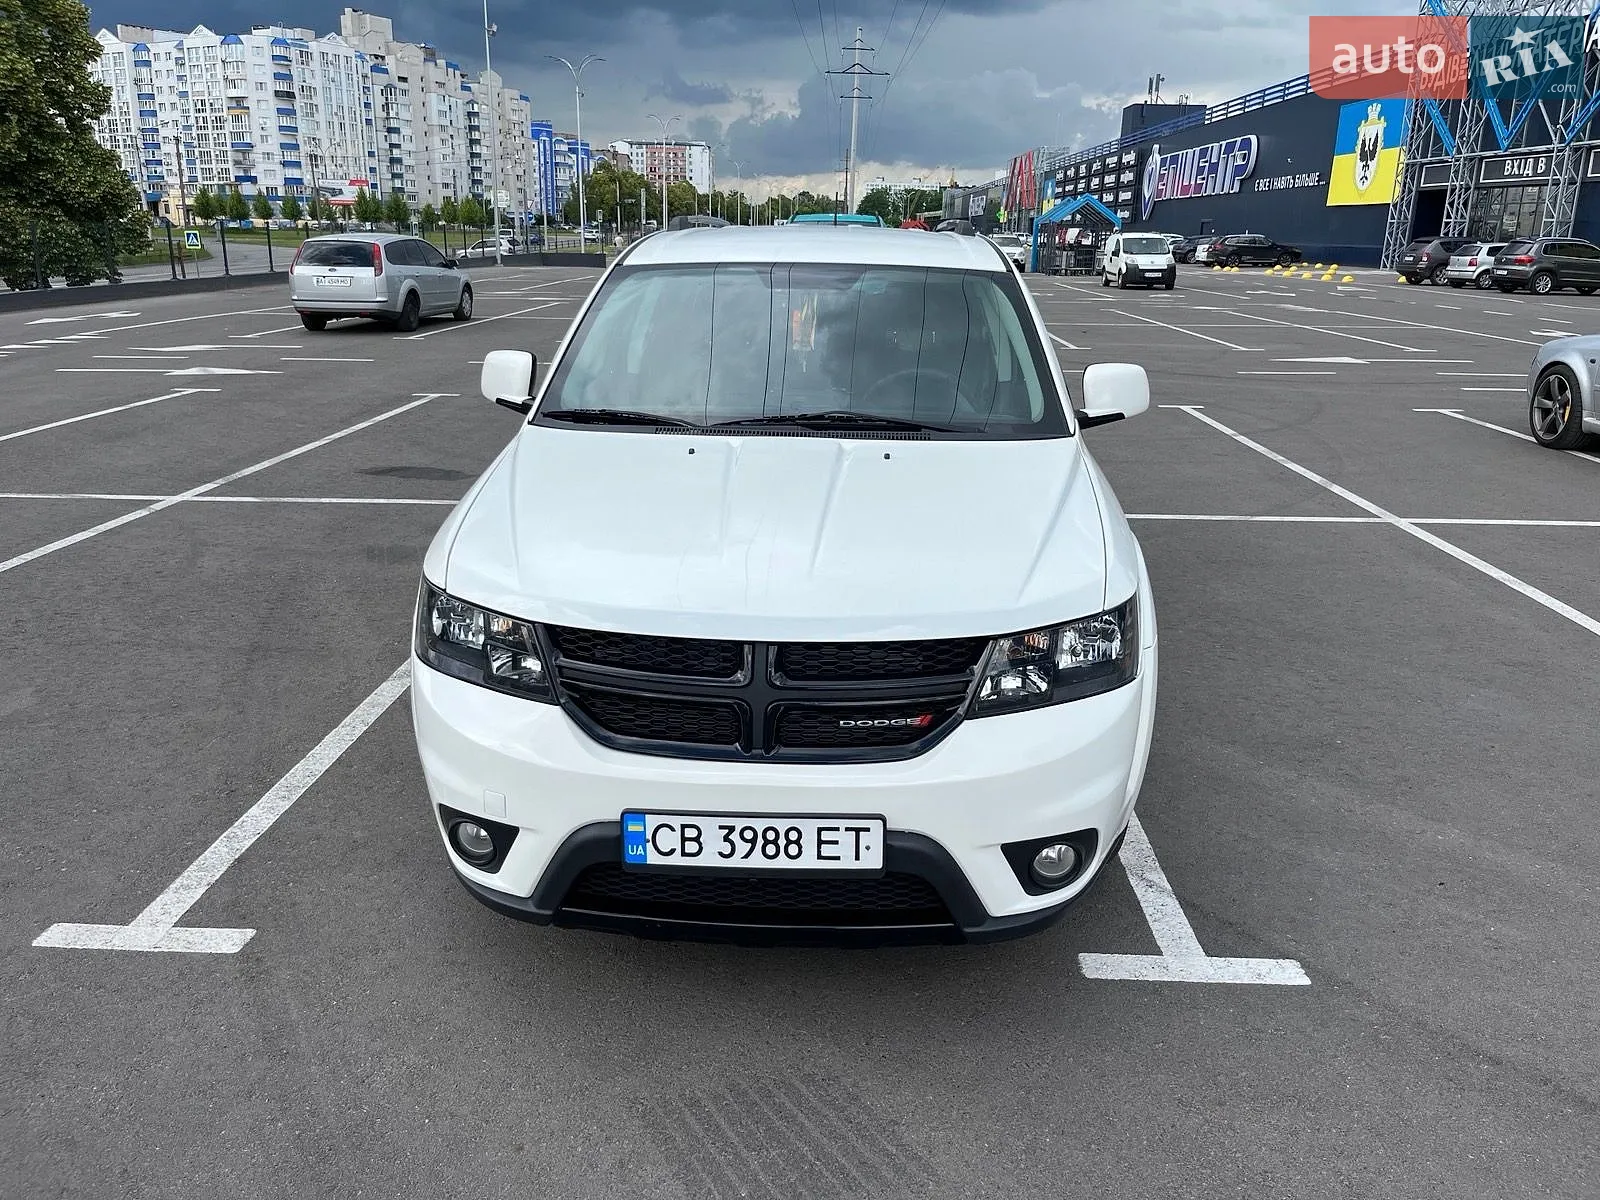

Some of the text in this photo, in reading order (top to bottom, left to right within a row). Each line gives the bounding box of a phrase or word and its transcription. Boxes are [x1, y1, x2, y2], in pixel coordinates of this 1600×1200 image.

[1504, 157, 1546, 176] ВХІД В
[1259, 178, 1270, 191] ВСЕ
[1273, 176, 1294, 190] НАВІТЬ
[840, 718, 921, 727] DODGE
[651, 823, 871, 861] CB 3988 ET
[628, 844, 644, 856] UA
